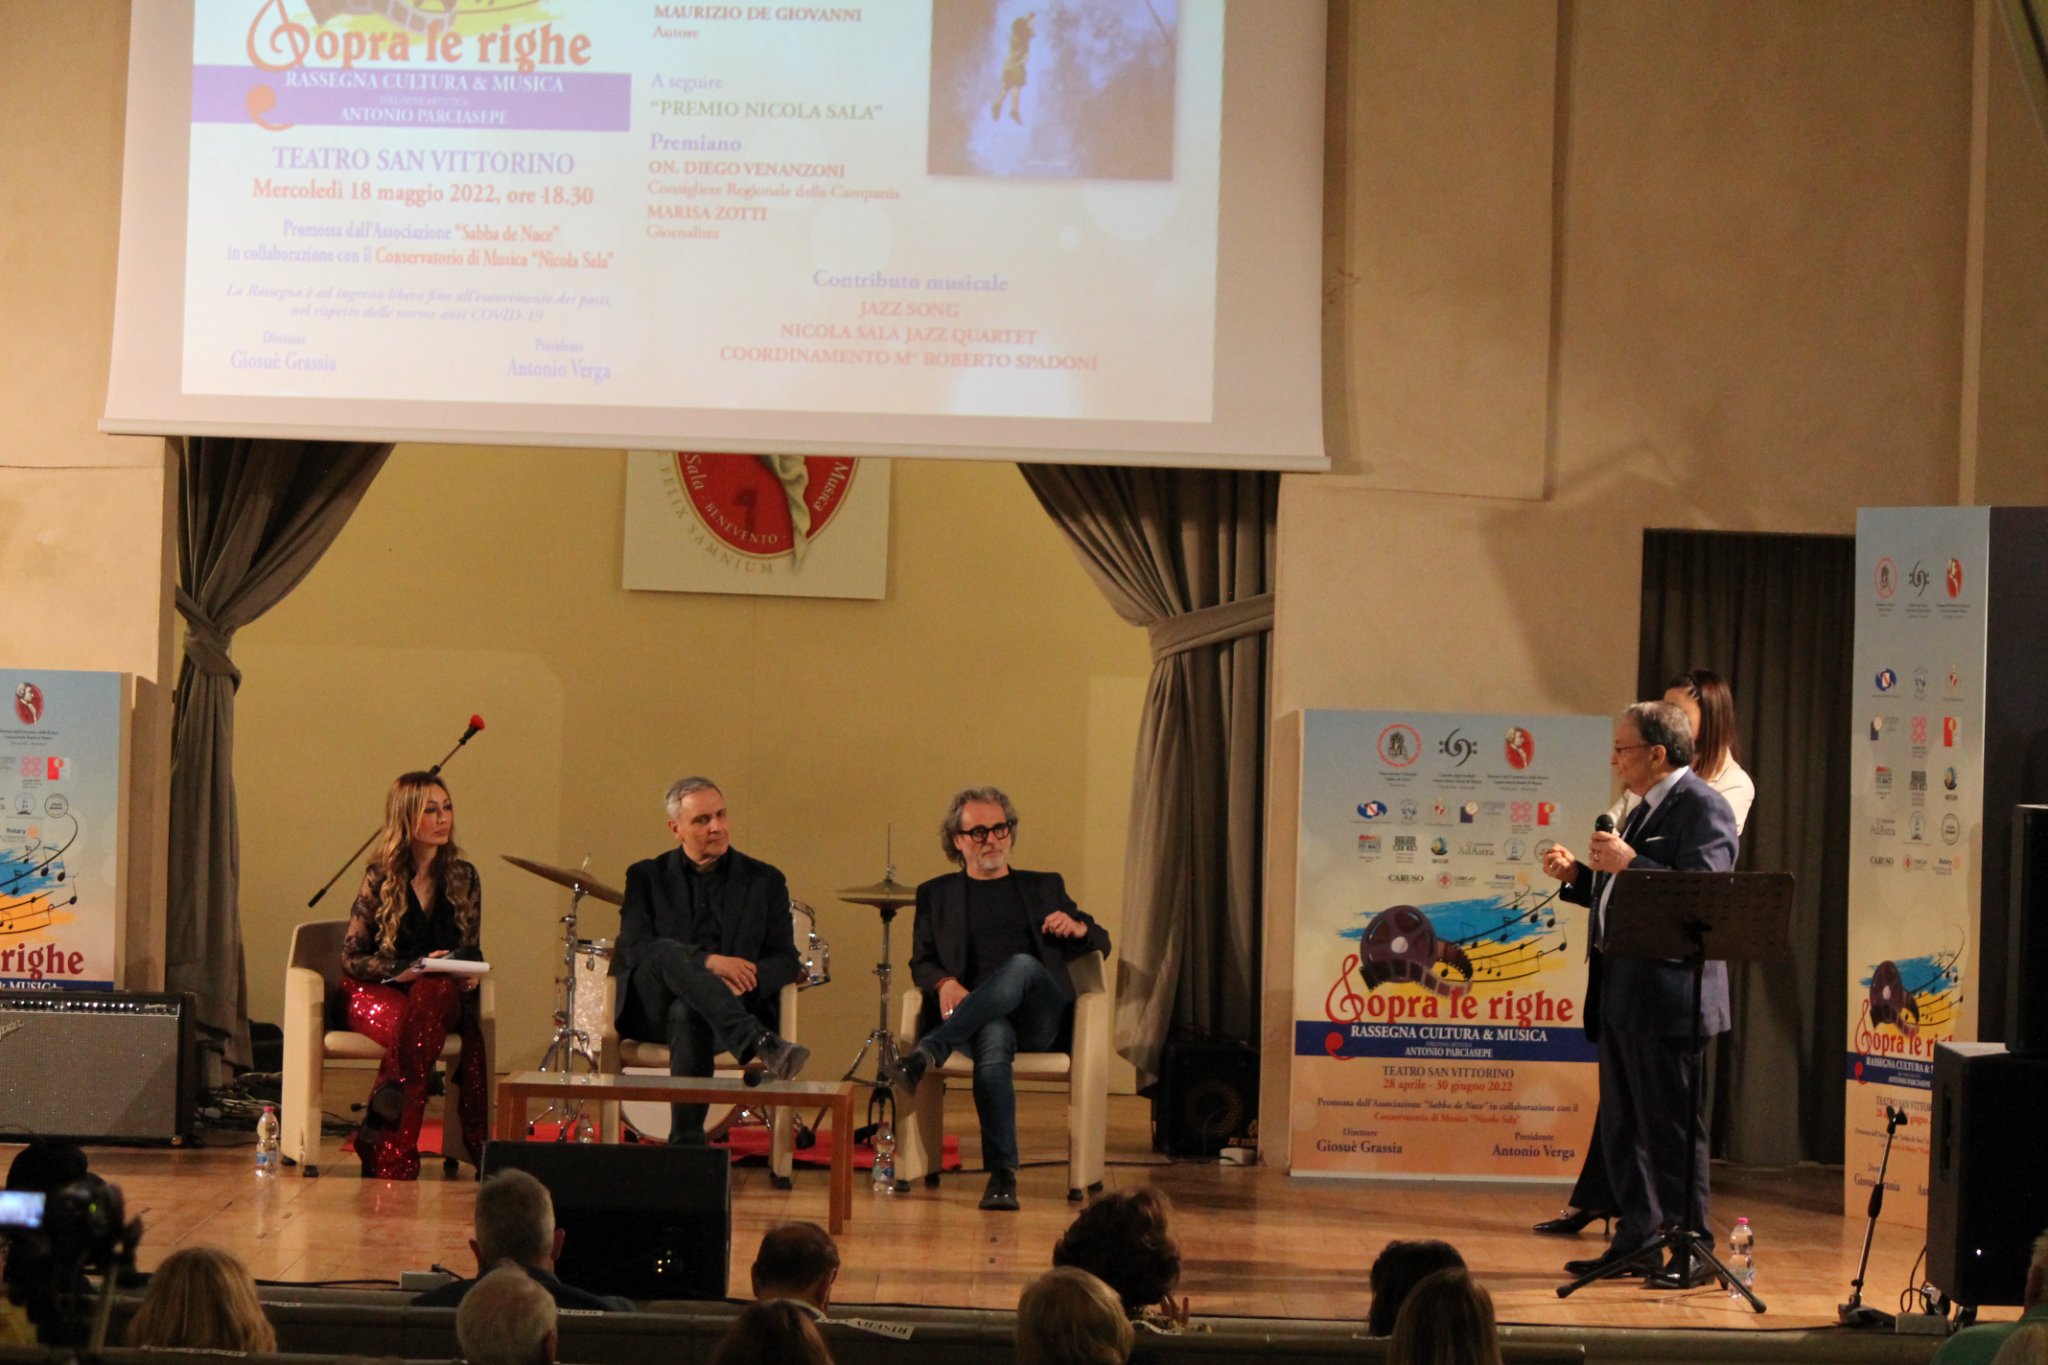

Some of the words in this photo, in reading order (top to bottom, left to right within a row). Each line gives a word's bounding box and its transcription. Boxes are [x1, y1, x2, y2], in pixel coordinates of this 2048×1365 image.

[653, 5, 743, 20] MAURIZIO
[746, 7, 770, 20] DE
[775, 7, 862, 22] GIOVANNI
[652, 25, 699, 39] Autore
[425, 18, 462, 63] le
[477, 22, 592, 75] righe
[285, 71, 378, 89] RASSEGNA
[382, 72, 468, 91] CULTURA
[473, 77, 487, 91] &
[493, 75, 565, 93] MUSICA
[650, 73, 664, 89] A
[668, 75, 724, 93] seguire
[339, 106, 413, 122] ANTONIO
[417, 108, 509, 125] PARCIASEPE
[744, 102, 822, 119] NICOLA
[650, 132, 742, 152] Premiano
[272, 146, 371, 170] TEATRO
[376, 148, 425, 171] SAN
[431, 149, 575, 175] VITTORINO
[647, 160, 679, 174] ON.
[683, 161, 740, 175] DIEGO
[743, 162, 846, 178] VENANZONI
[252, 177, 343, 199] Mercoledì
[351, 181, 371, 200] 18
[377, 182, 444, 207] maggio
[449, 184, 500, 205] 2022,
[507, 190, 536, 204] ore
[543, 186, 594, 206] 18.30
[726, 182, 791, 200] Regionale
[829, 185, 901, 203] Campania
[647, 204, 711, 220] MARISA
[714, 206, 767, 221] ZOTTI
[283, 219, 342, 237] Promossa
[502, 225, 517, 241] de
[227, 244, 240, 260] in
[243, 244, 334, 262] collaborazione
[337, 251, 360, 263] con
[375, 246, 463, 265] Conservatorio
[467, 250, 480, 266] di
[483, 250, 528, 267] Musica
[812, 269, 920, 289] Contributo
[926, 274, 1008, 291] musicale
[859, 301, 902, 318] JAZZ
[905, 302, 959, 318] SONG
[780, 323, 851, 339] NICOLA
[855, 325, 899, 340] SALA
[904, 326, 948, 343] JAZZ
[951, 328, 1038, 345] QUARTET
[719, 346, 889, 365] COORDINAMENTO
[923, 352, 1011, 369] ROBERTO
[1015, 355, 1100, 371] SPADONI
[507, 358, 567, 377] Antonio
[570, 358, 611, 385] Verga
[813, 460, 849, 512] Musica
[704, 502, 778, 544] BENEVENTO
[688, 524, 773, 573] SAMNIUM
[1388, 874, 1424, 882] CARUSO
[1, 943, 84, 981] righe
[1449, 987, 1478, 1019] le
[1488, 990, 1573, 1028] righe
[1351, 1025, 1416, 1038] RASSEGNA
[1419, 1026, 1480, 1040] CULTURA
[1482, 1029, 1494, 1040] &
[1496, 1029, 1548, 1042] MUSICA
[1909, 1030, 1922, 1055] le
[1404, 1047, 1444, 1057] ANTONIO
[1445, 1048, 1493, 1058] PARCIASEPE
[1866, 1056, 1896, 1069] RASSEGNA
[1383, 1065, 1425, 1076] TEATRO
[1428, 1066, 1449, 1077] SAN
[1450, 1067, 1514, 1078] VITTORINO
[1383, 1079, 1395, 1088] 28
[1398, 1079, 1426, 1092] aprile
[1435, 1080, 1448, 1090] 30
[1450, 1081, 1485, 1093] giugno
[1487, 1081, 1513, 1092] 2022
[1360, 1140, 1403, 1154] Grassia
[1492, 1144, 1540, 1157] Antonio
[1543, 1145, 1575, 1161] Verga
